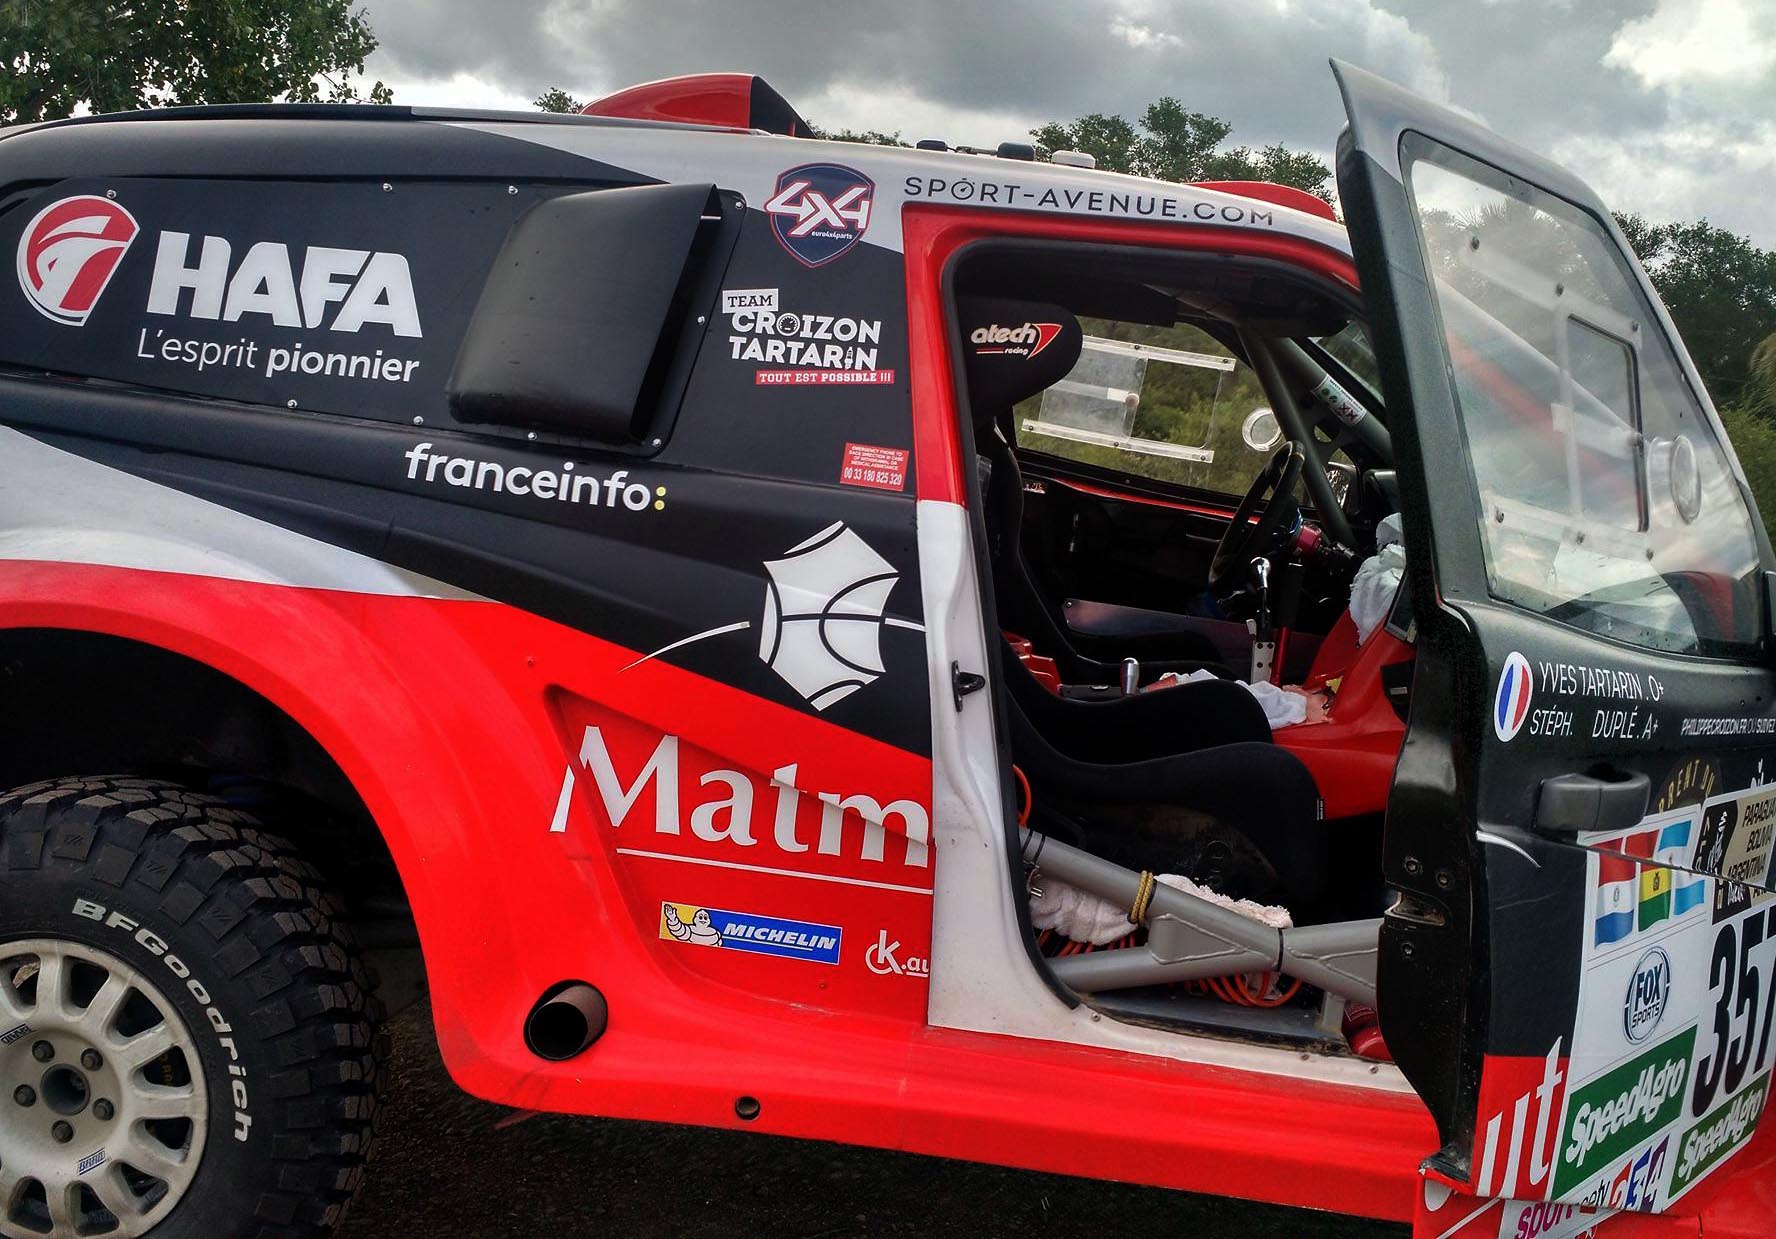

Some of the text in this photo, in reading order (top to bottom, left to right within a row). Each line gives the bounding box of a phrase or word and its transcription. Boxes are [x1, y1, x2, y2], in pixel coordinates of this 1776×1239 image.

[903, 176, 1273, 227] SPORT-AVENUE.COM
[811, 230, 853, 240] euro4x4parts
[146, 230, 423, 338] HAFA
[727, 294, 773, 307] TEAM
[731, 309, 882, 345] CROIZON
[970, 322, 1037, 344] atech
[138, 328, 419, 382] L'esprit pionnier
[729, 335, 878, 372] TARTARIN
[1004, 347, 1029, 356] racing
[759, 373, 791, 383] TOUT
[795, 373, 817, 383] EST
[821, 373, 876, 383] POSSIBLE
[853, 468, 862, 480] 33
[864, 470, 876, 482] 180
[1539, 661, 1577, 695] YVES
[1578, 666, 1643, 700] TARTARIN
[1529, 704, 1573, 735] STÉPH.
[1591, 705, 1638, 739] DUPLÉ
[722, 923, 837, 950] MICHELIN
[1634, 963, 1663, 1011] FOX
[71, 898, 252, 1142] BFGoodrich
[1631, 1002, 1661, 1029] SPORTS
[1565, 1057, 1687, 1168] SpeedAgro
[1678, 1087, 1764, 1180] SpeedAgro
